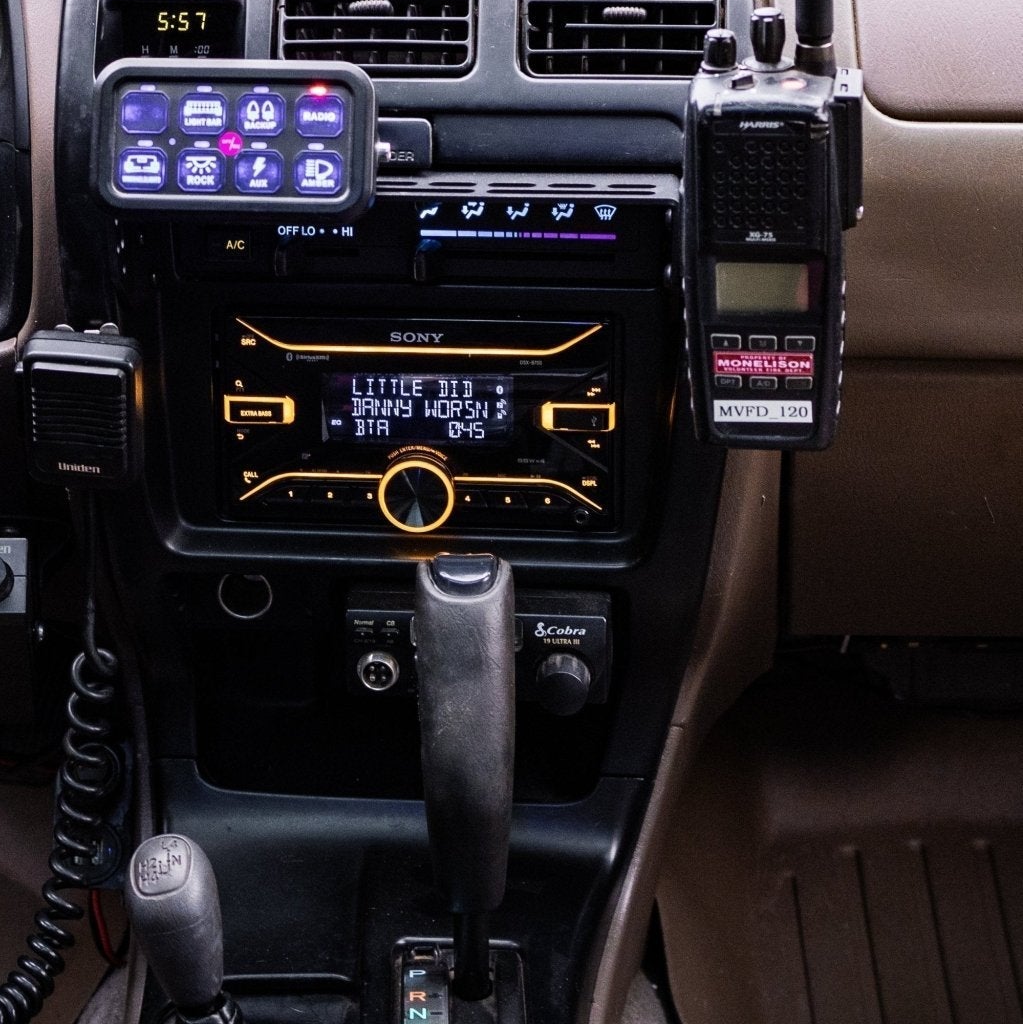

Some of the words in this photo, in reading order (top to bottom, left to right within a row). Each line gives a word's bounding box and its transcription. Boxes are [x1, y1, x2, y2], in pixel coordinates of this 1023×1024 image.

[157, 12, 206, 31] 5:57
[142, 45, 149, 54] H
[169, 45, 178, 54] M
[302, 111, 336, 122] RADIO
[249, 179, 268, 188] AUX
[277, 225, 299, 236] OFF
[301, 225, 316, 236] LO
[341, 226, 354, 237] HI
[226, 240, 245, 250] A/C
[390, 331, 444, 343] SONY
[717, 359, 811, 369] MONELISON
[352, 378, 423, 397] LITTLE
[438, 380, 473, 397] DID
[351, 397, 412, 417] DANNY
[424, 399, 488, 419] WORSN
[719, 405, 808, 420] MVFD_120
[355, 419, 389, 436] BTA
[58, 462, 101, 474] Uniden
[288, 490, 294, 498] 1
[327, 491, 334, 499] 2
[366, 492, 373, 500] 3
[504, 496, 511, 504] 5
[547, 626, 586, 636] Cobra
[409, 969, 426, 978] P
[409, 991, 426, 1002] R
[409, 1007, 426, 1020] N
